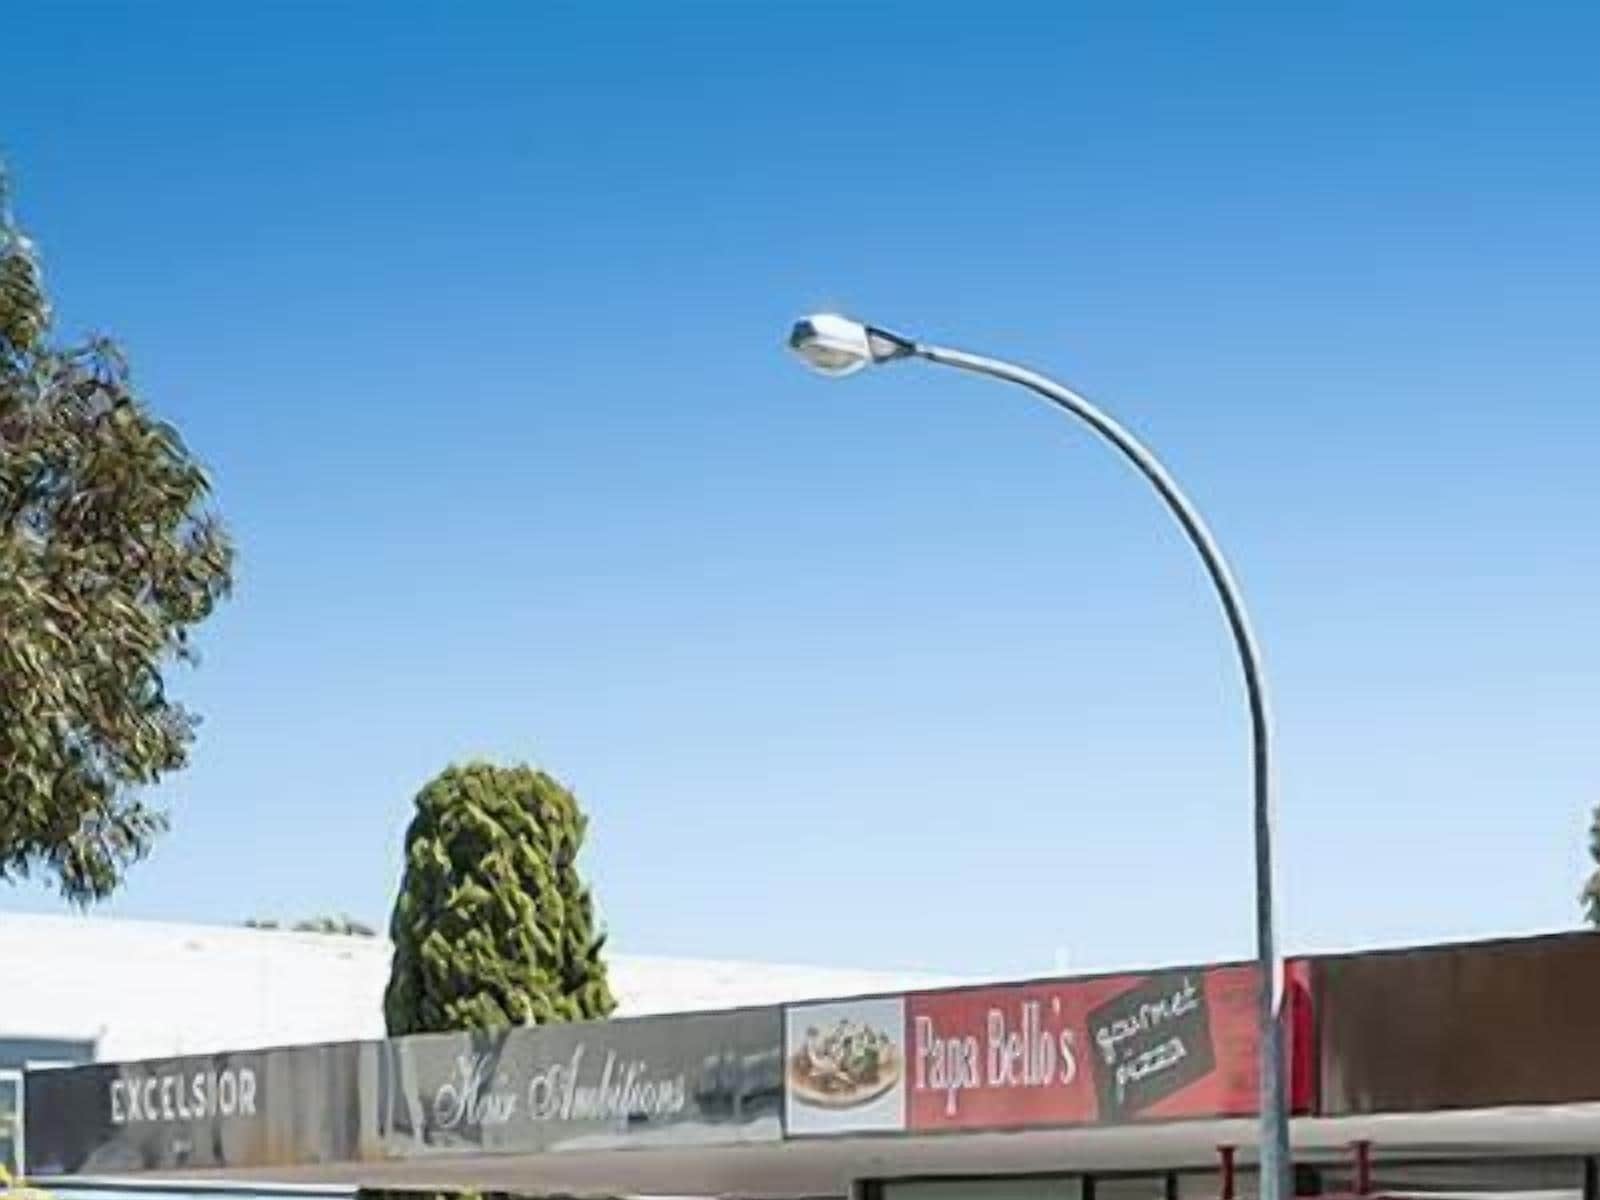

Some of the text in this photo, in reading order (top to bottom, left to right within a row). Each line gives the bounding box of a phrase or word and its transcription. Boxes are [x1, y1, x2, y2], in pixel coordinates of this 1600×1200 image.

[915, 995, 1077, 1116] Papa Bello's
[1115, 1036, 1188, 1105] pizza
[110, 1067, 257, 1124] EXCELSIOR
